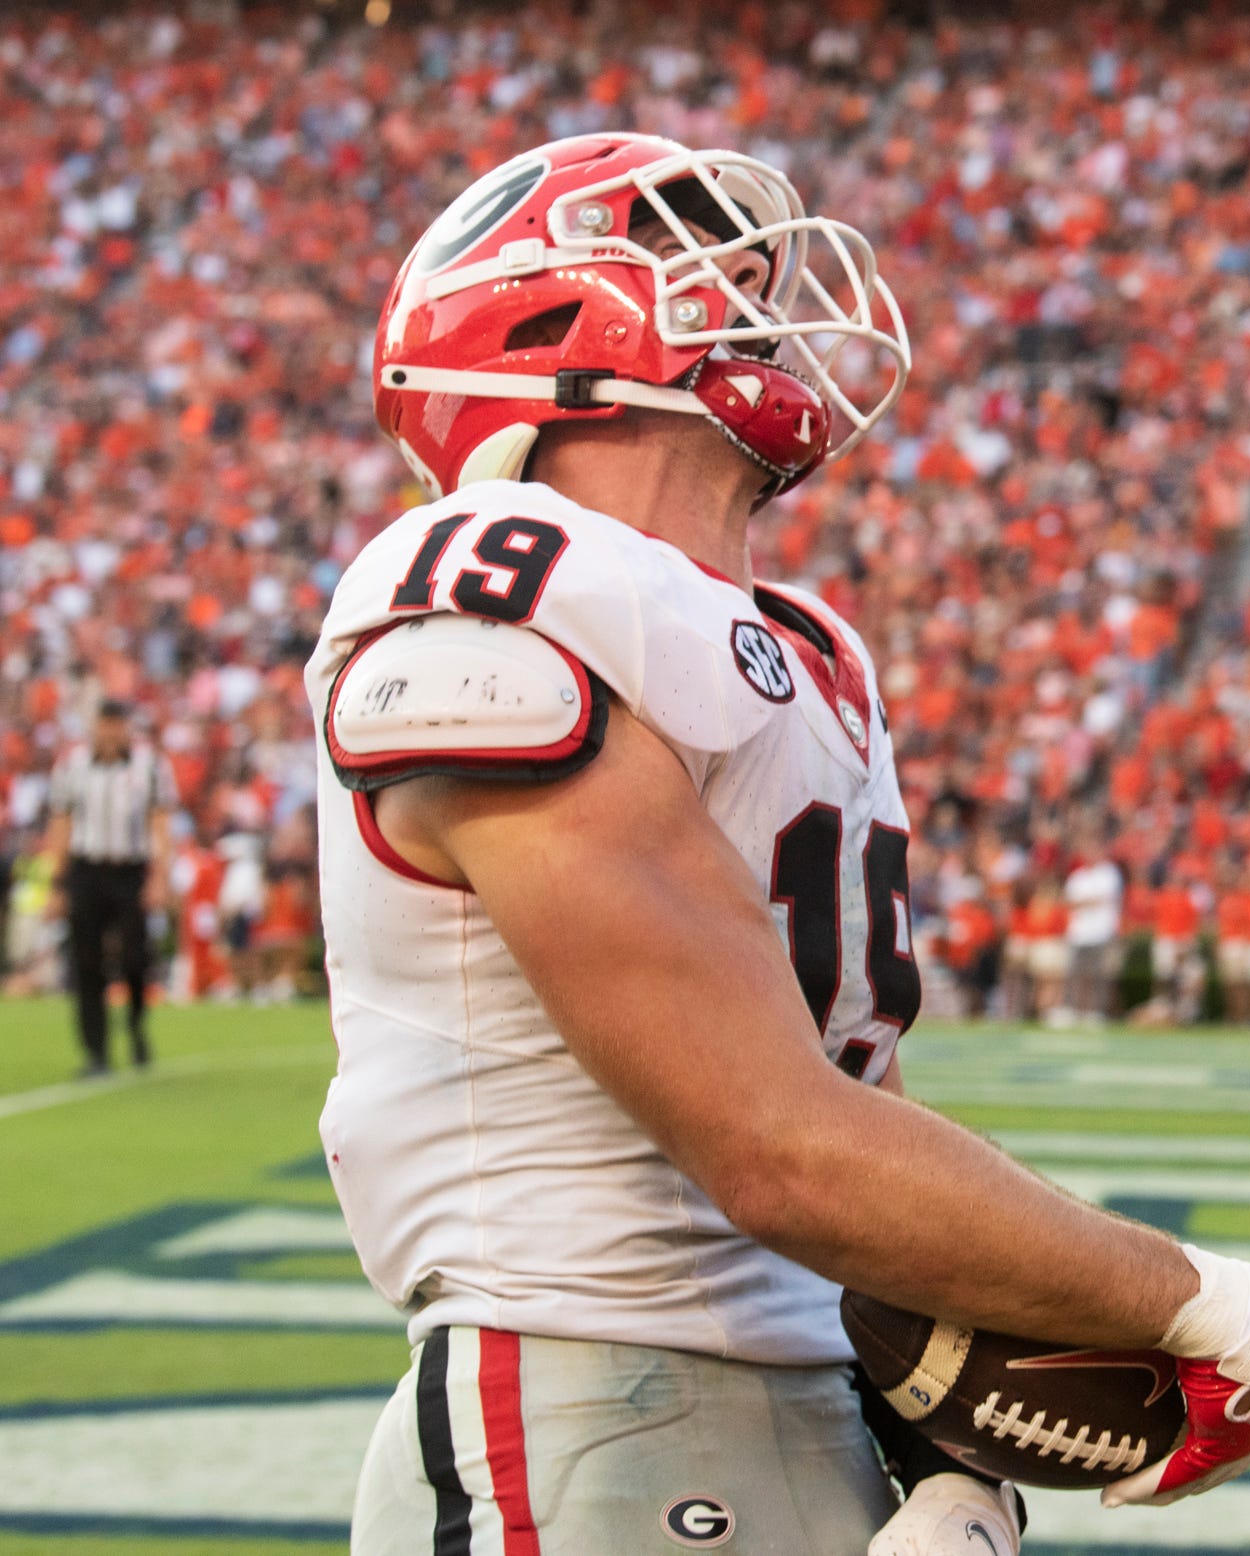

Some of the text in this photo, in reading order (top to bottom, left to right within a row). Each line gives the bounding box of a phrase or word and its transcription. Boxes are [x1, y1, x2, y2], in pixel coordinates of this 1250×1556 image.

[389, 513, 570, 624] 19
[735, 622, 793, 698] SEC
[665, 1497, 730, 1541] G
